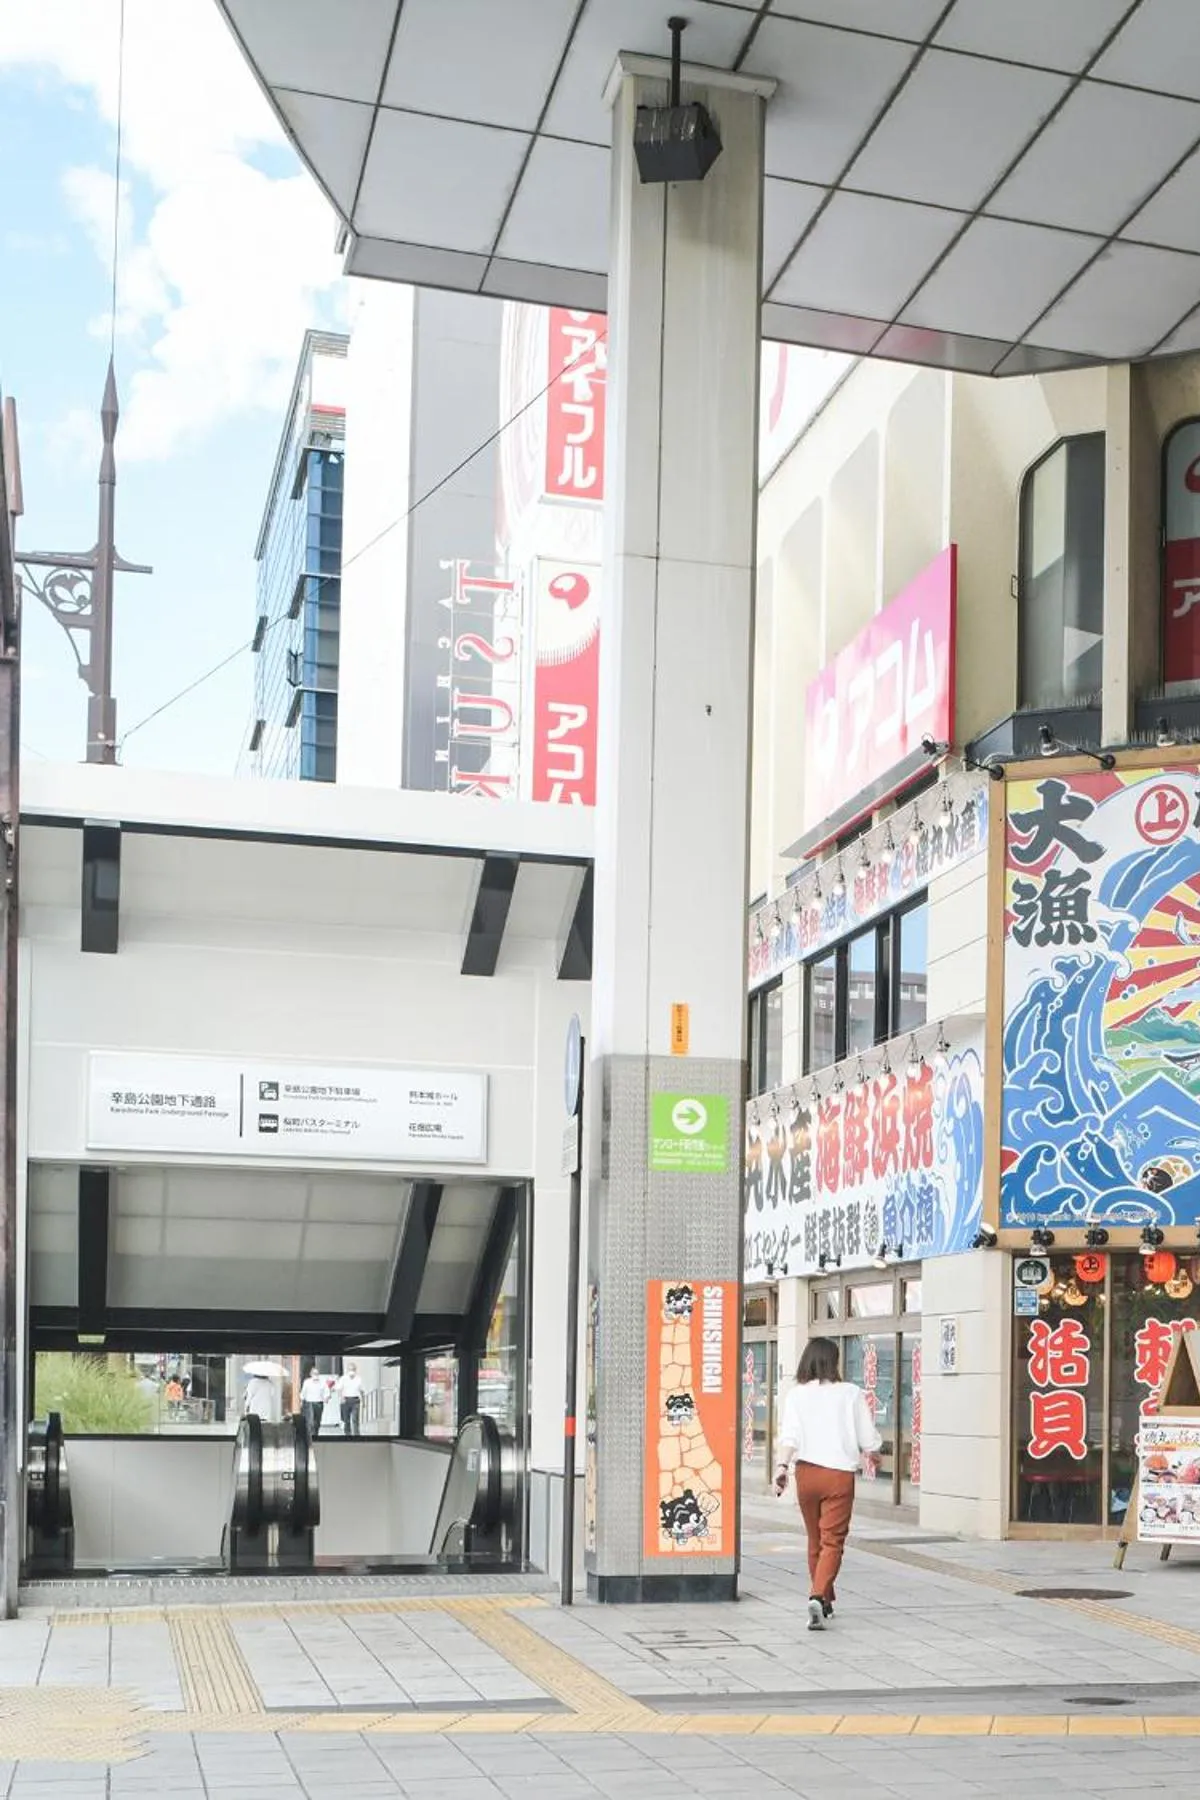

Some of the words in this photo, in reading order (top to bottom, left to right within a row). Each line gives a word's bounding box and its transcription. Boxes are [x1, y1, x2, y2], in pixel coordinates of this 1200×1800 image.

[557, 325, 597, 488] アイフル
[1008, 778, 1105, 948] 大漁
[815, 1064, 935, 1193] 海鮮浜焼
[1028, 1317, 1090, 1460] 活貝
